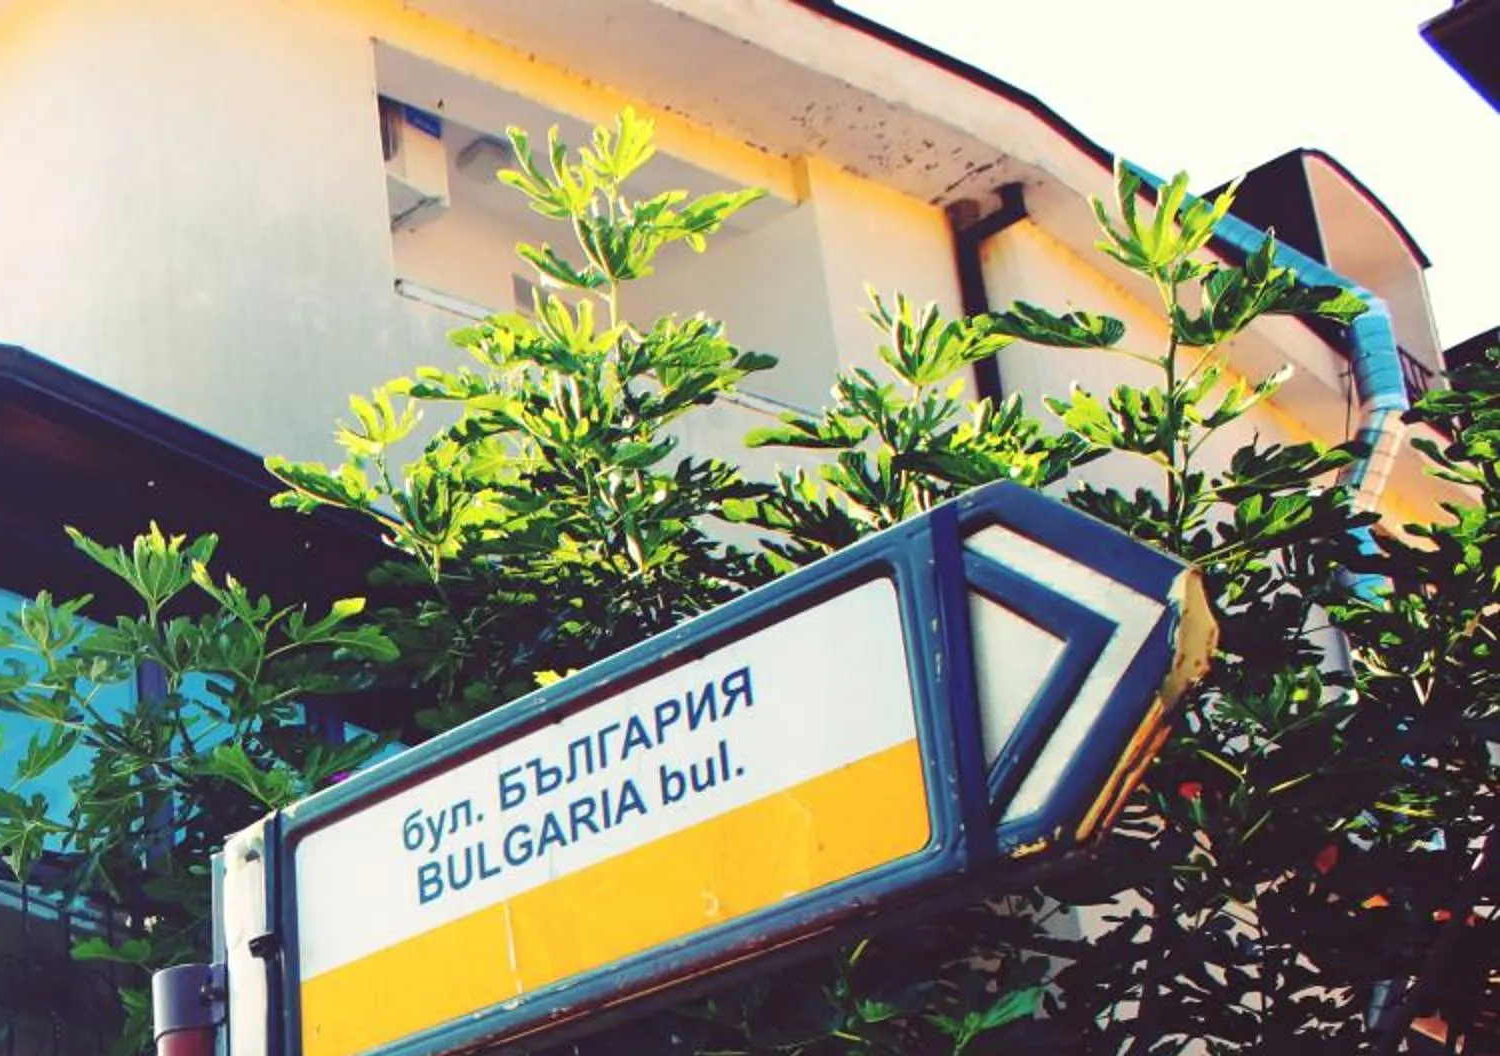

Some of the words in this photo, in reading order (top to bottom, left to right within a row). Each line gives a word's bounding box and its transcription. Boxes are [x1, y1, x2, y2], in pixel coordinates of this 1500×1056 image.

[402, 799, 483, 853] бул.
[498, 666, 755, 811] БЪЛГАРИЯ
[417, 778, 648, 904] BULGARIA
[659, 740, 745, 805] bul.
